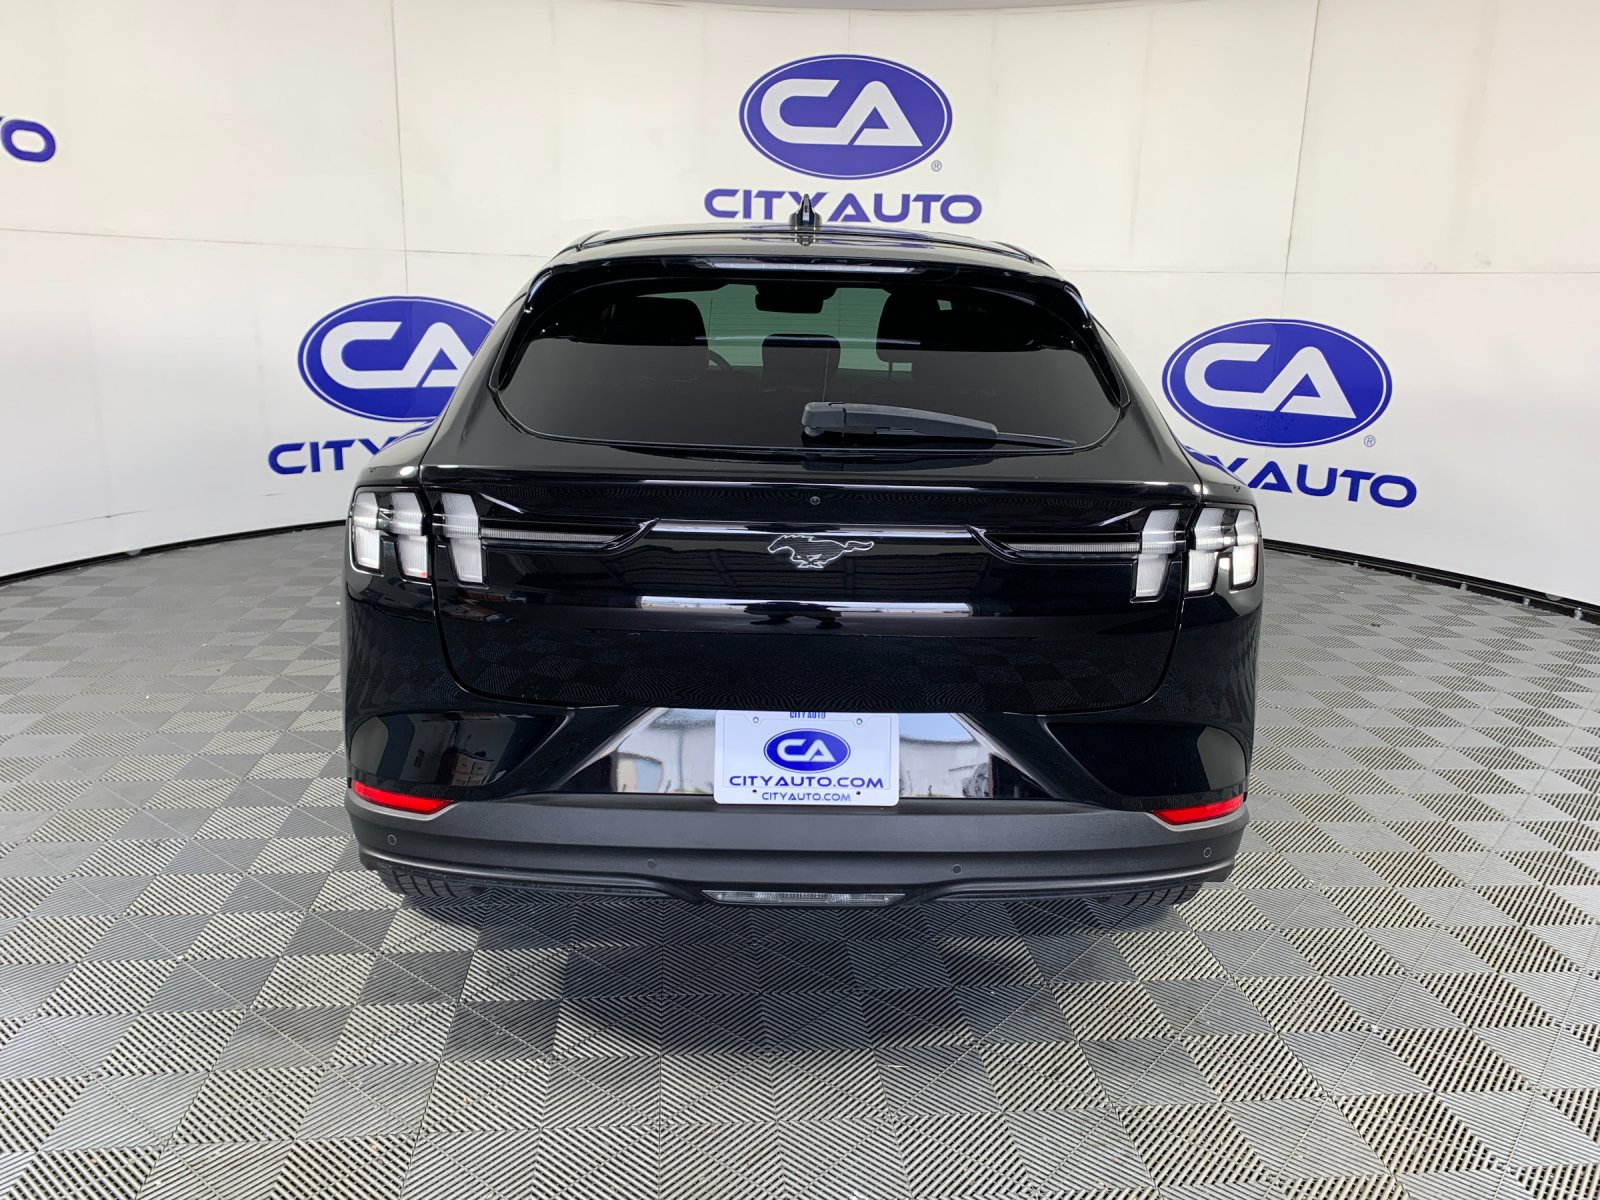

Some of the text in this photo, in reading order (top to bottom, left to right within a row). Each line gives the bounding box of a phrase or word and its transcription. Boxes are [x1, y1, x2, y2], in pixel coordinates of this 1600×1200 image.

[760, 78, 923, 147] CA
[320, 321, 474, 389] CA
[1184, 342, 1357, 419] CA
[777, 739, 837, 763] CA
[729, 776, 884, 788] CITYAUTO.COM
[762, 792, 851, 801] CITYAUTO.COM
